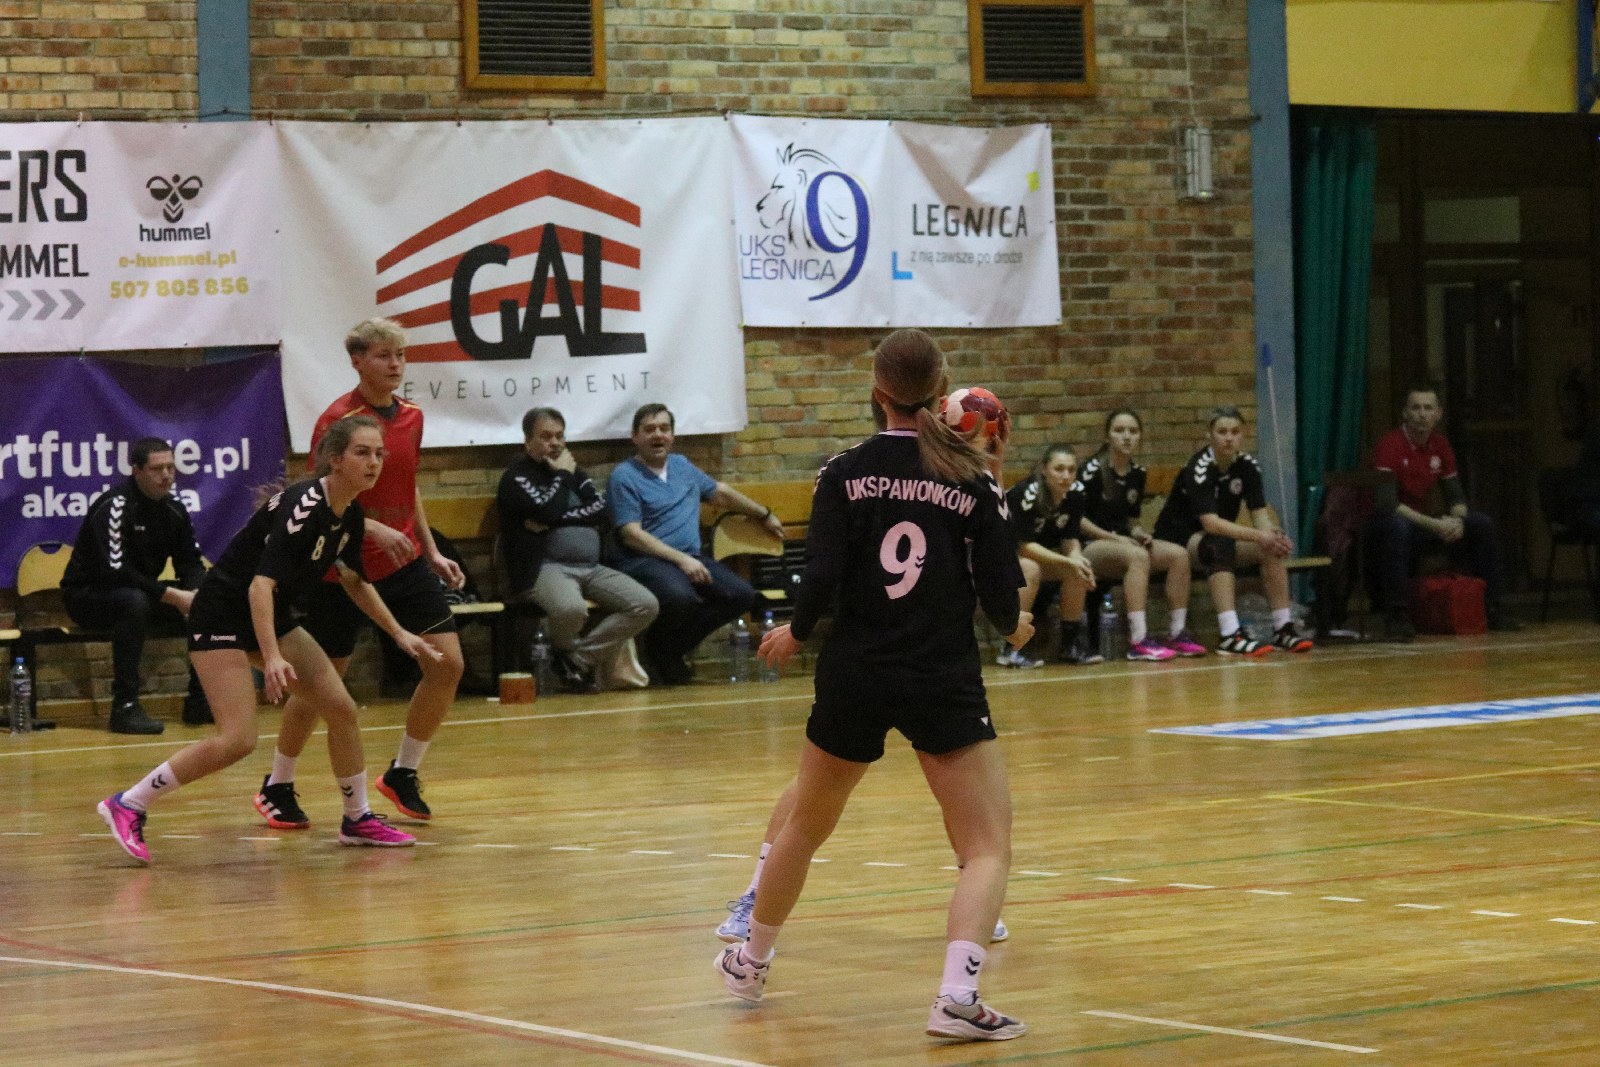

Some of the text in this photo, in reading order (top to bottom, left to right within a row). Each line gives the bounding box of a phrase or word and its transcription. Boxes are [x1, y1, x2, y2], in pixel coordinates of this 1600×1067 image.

[140, 222, 211, 241] hummel
[912, 203, 1028, 237] LEGNICA
[740, 235, 785, 256] UKS
[806, 171, 870, 301] 9
[0, 244, 89, 278] MMEL
[119, 249, 236, 268] e-hummel.pl
[740, 258, 836, 280] LEGNICA
[110, 276, 249, 299] 507 805 856
[451, 222, 647, 361] GAL
[403, 371, 650, 400] EVELOPMENT
[0, 430, 250, 479] rtfute.pl
[22, 482, 201, 518] akaa
[311, 535, 326, 561] 8
[879, 520, 927, 600] 9
